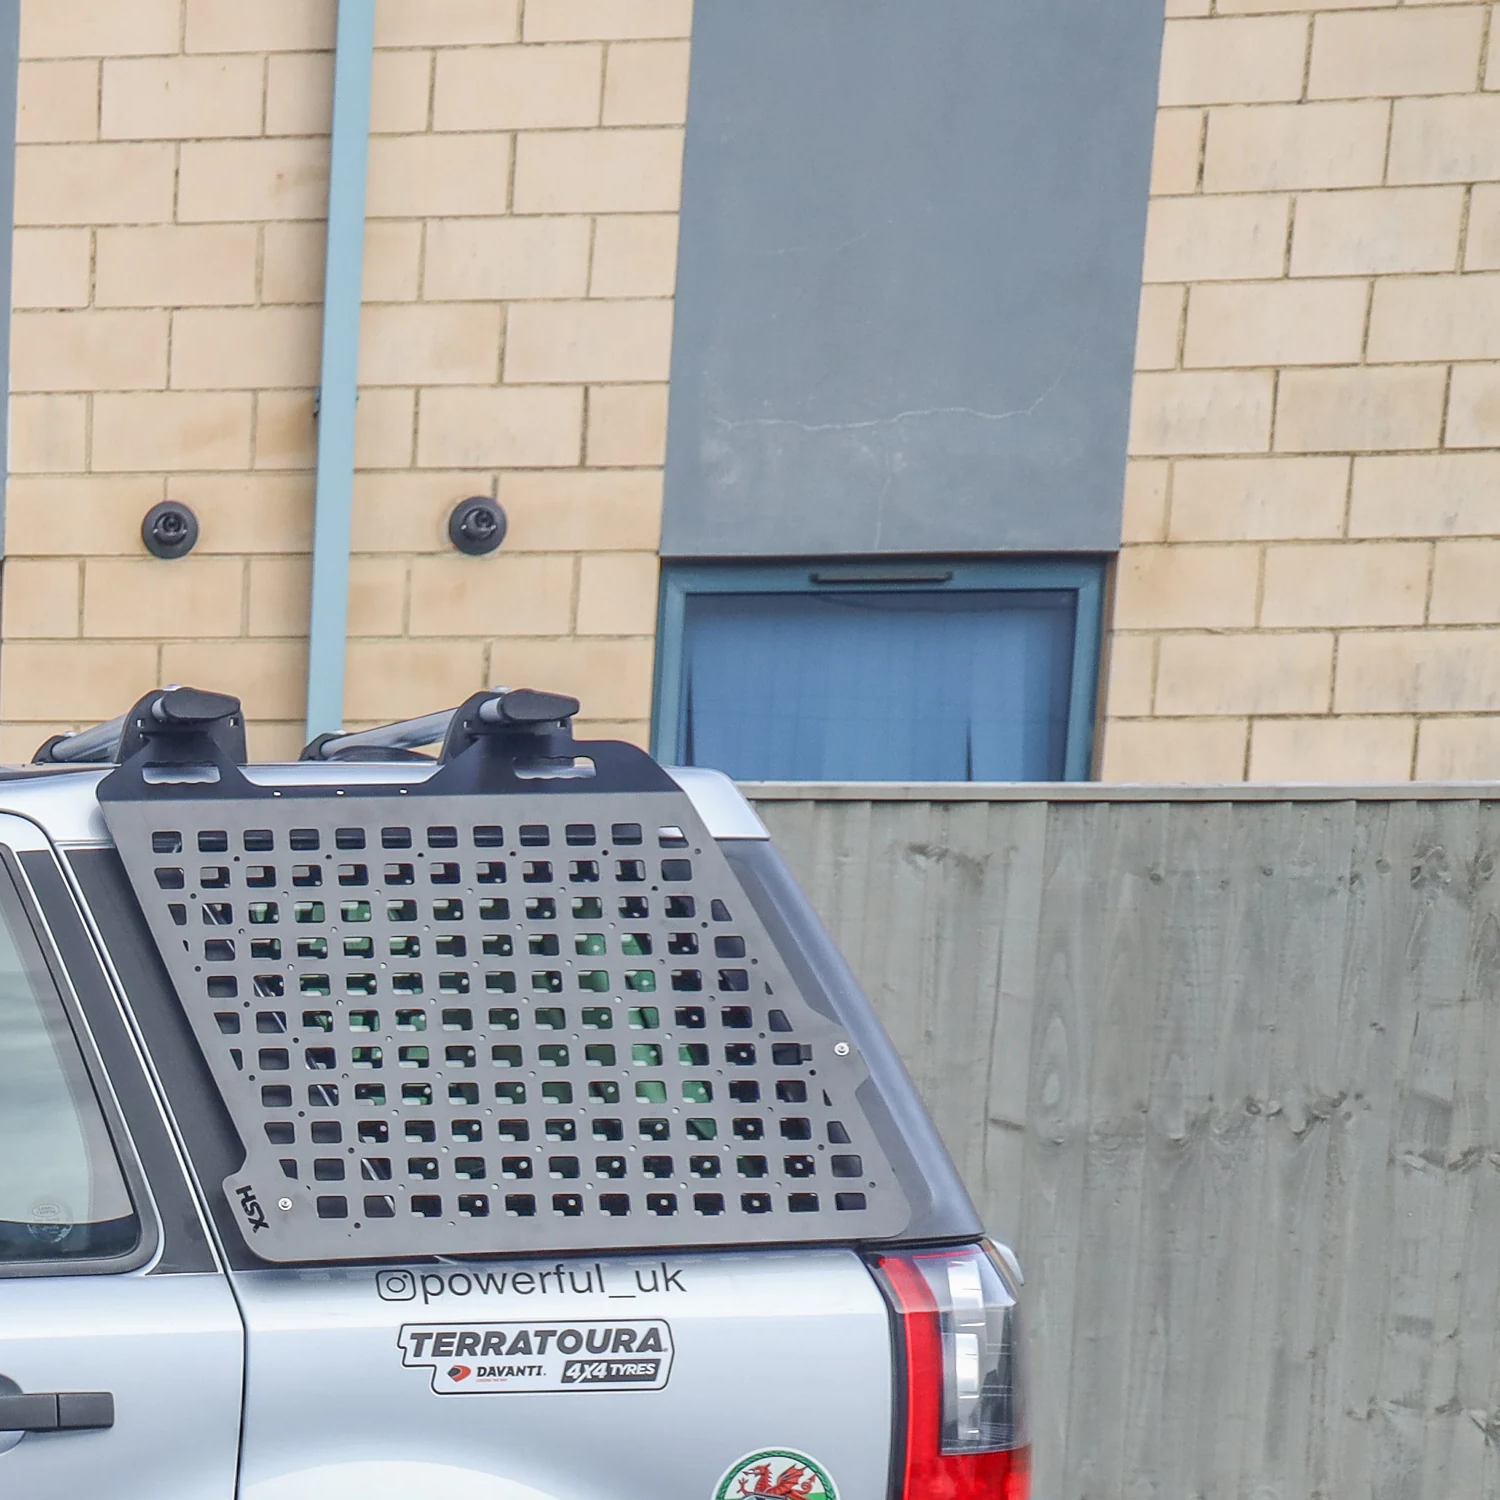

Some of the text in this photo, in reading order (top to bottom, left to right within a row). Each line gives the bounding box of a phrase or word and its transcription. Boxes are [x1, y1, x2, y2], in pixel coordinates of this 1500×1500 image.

[235, 1185, 270, 1234] HSX
[419, 1261, 688, 1305] powerful_uk
[409, 1327, 662, 1358] TERRATOURA
[476, 1365, 543, 1378] DAVANTI
[610, 1362, 657, 1377] TYRES
